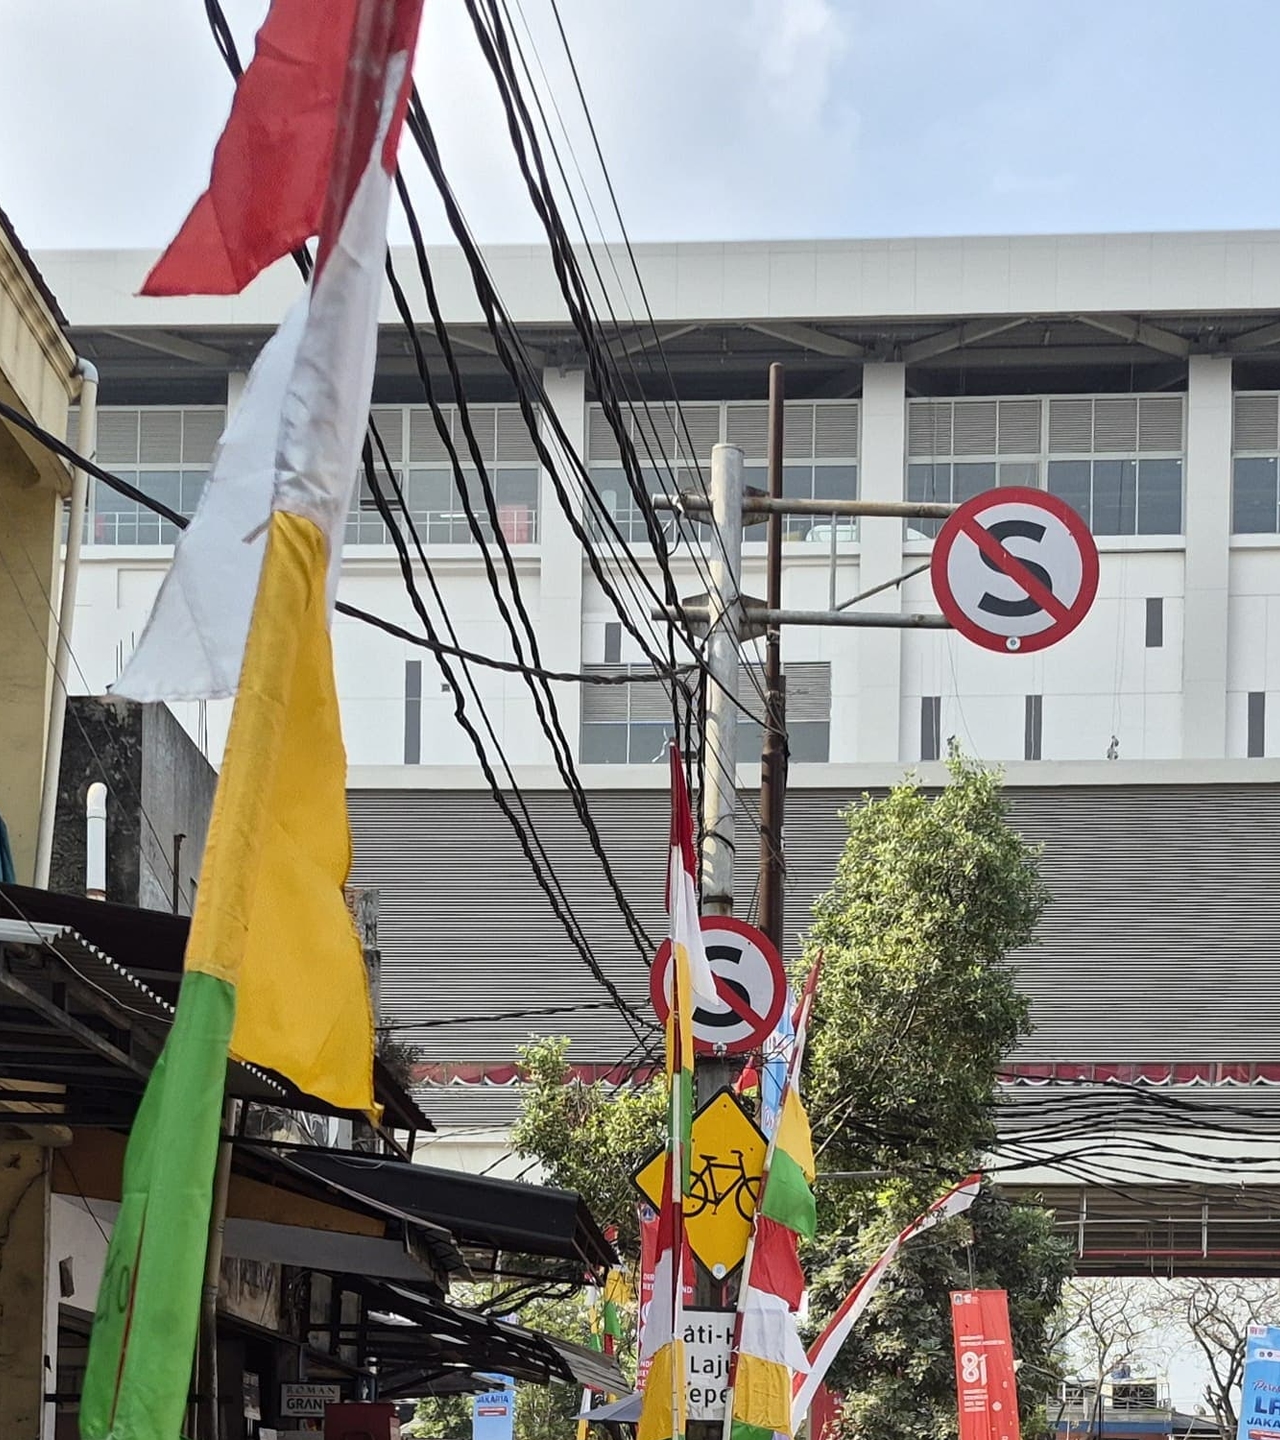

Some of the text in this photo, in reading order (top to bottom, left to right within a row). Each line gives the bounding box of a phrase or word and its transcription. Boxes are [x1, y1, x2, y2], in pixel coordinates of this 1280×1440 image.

[960, 1351, 988, 1386] 81
[286, 1385, 335, 1394] ROMAN
[685, 1382, 727, 1408] epe
